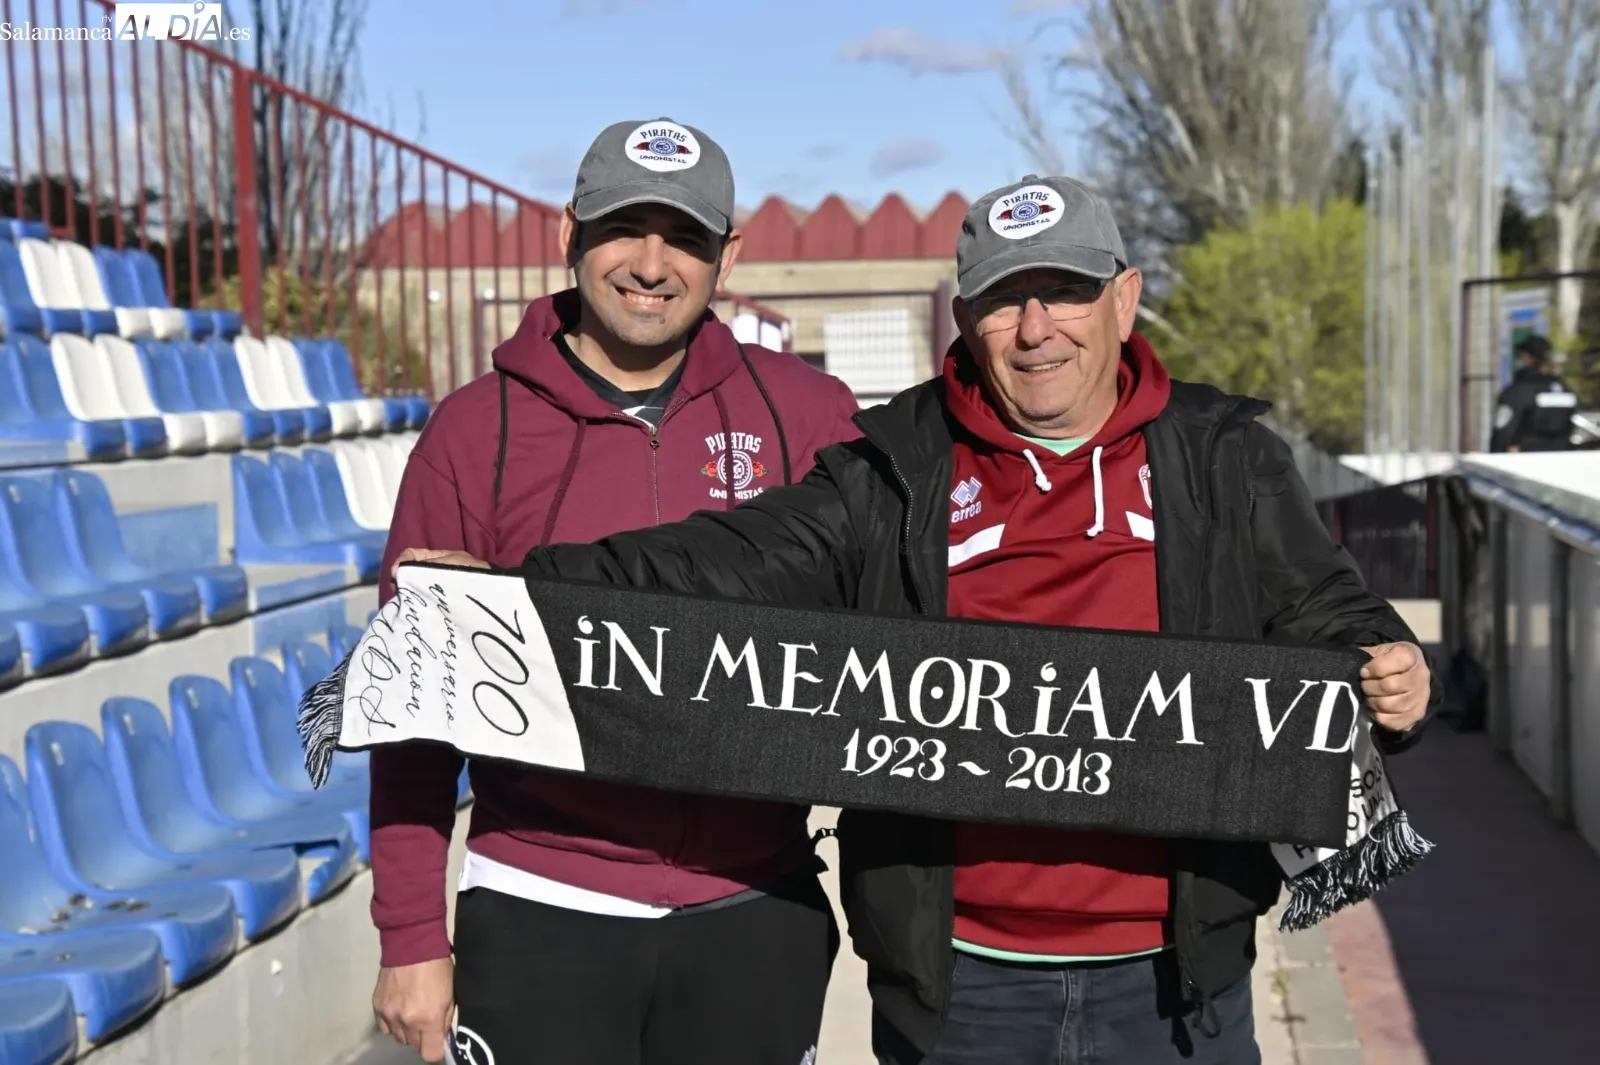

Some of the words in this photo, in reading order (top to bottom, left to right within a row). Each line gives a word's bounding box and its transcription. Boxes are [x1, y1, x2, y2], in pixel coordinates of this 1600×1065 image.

[640, 128, 687, 142] PIRATAS
[640, 155, 687, 164] UNIONISTAS
[1003, 191, 1049, 206] PIRATAS
[1003, 218, 1051, 231] UNIONISTAS
[709, 487, 764, 500] UNINISTAS
[951, 500, 982, 524] errea
[428, 583, 457, 730] aniversario
[465, 593, 530, 737] 100
[841, 728, 947, 781] 1923
[1005, 747, 1112, 795] 2013
